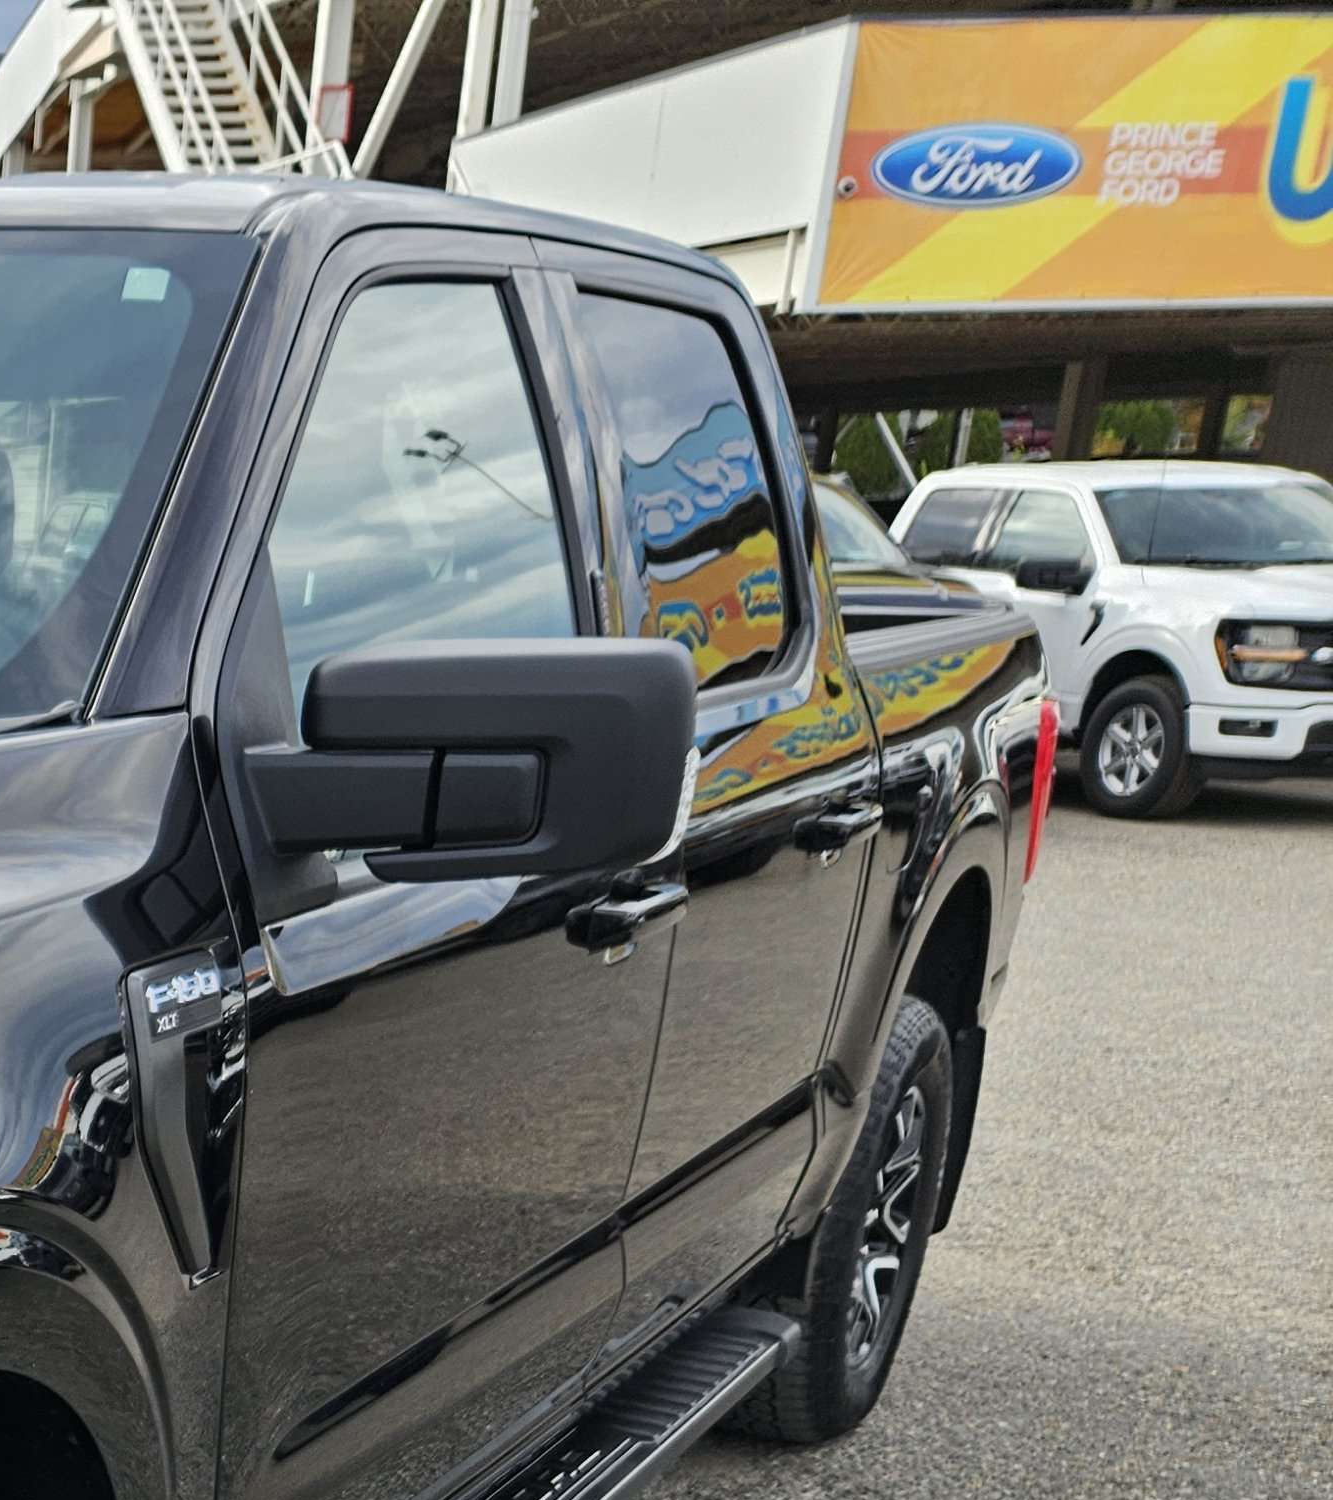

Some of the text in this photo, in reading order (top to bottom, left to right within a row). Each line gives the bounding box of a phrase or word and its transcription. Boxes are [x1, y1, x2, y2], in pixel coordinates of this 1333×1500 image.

[1108, 121, 1221, 148] PRINCE
[910, 135, 1041, 195] Ford
[1102, 149, 1226, 178] GEORGE
[1096, 179, 1181, 207] FORD
[156, 1012, 179, 1034] XLT
